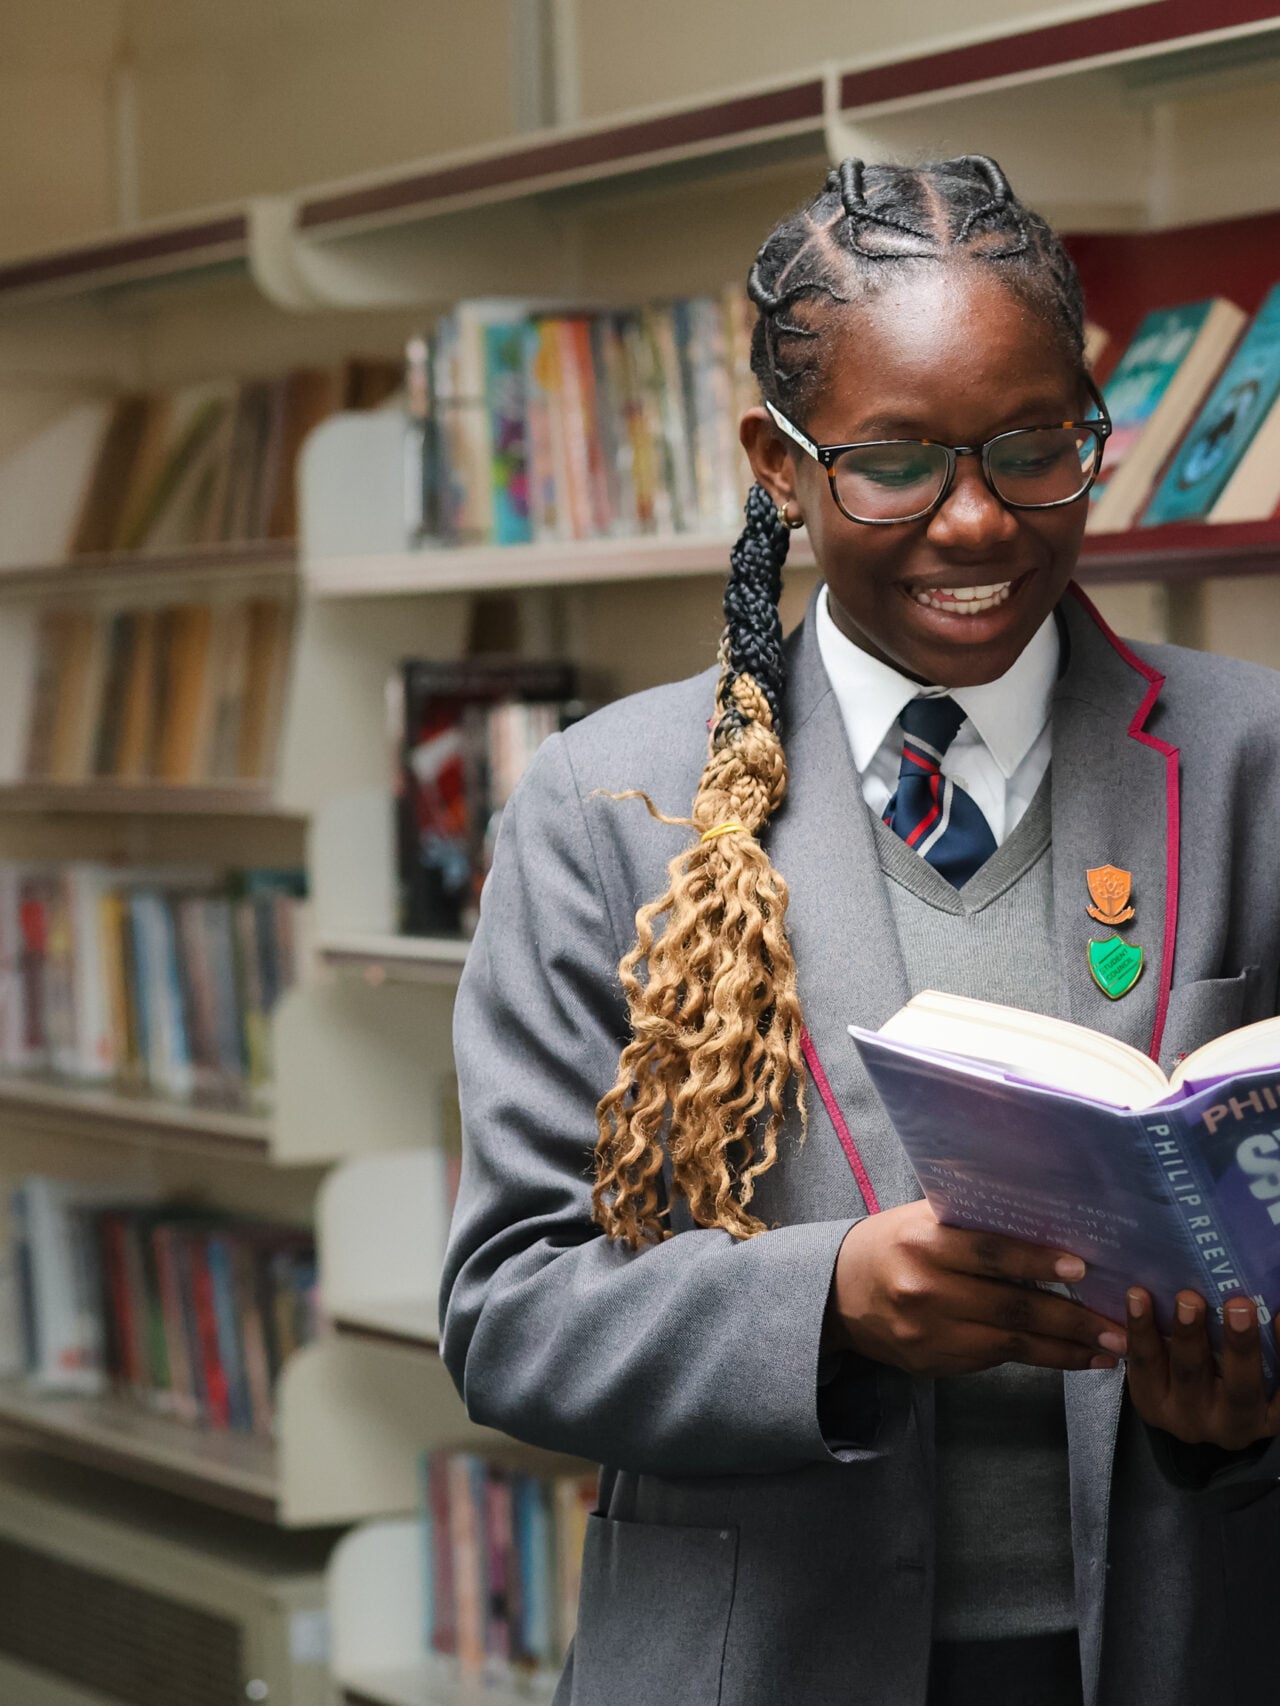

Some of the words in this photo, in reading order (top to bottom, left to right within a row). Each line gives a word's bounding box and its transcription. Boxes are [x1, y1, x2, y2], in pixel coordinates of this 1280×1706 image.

[1100, 948, 1129, 975] STUDENT
[1105, 957, 1134, 982] COUNCIL
[1145, 1122, 1201, 1208] PHILIP
[1185, 1212, 1243, 1301] REEVE
